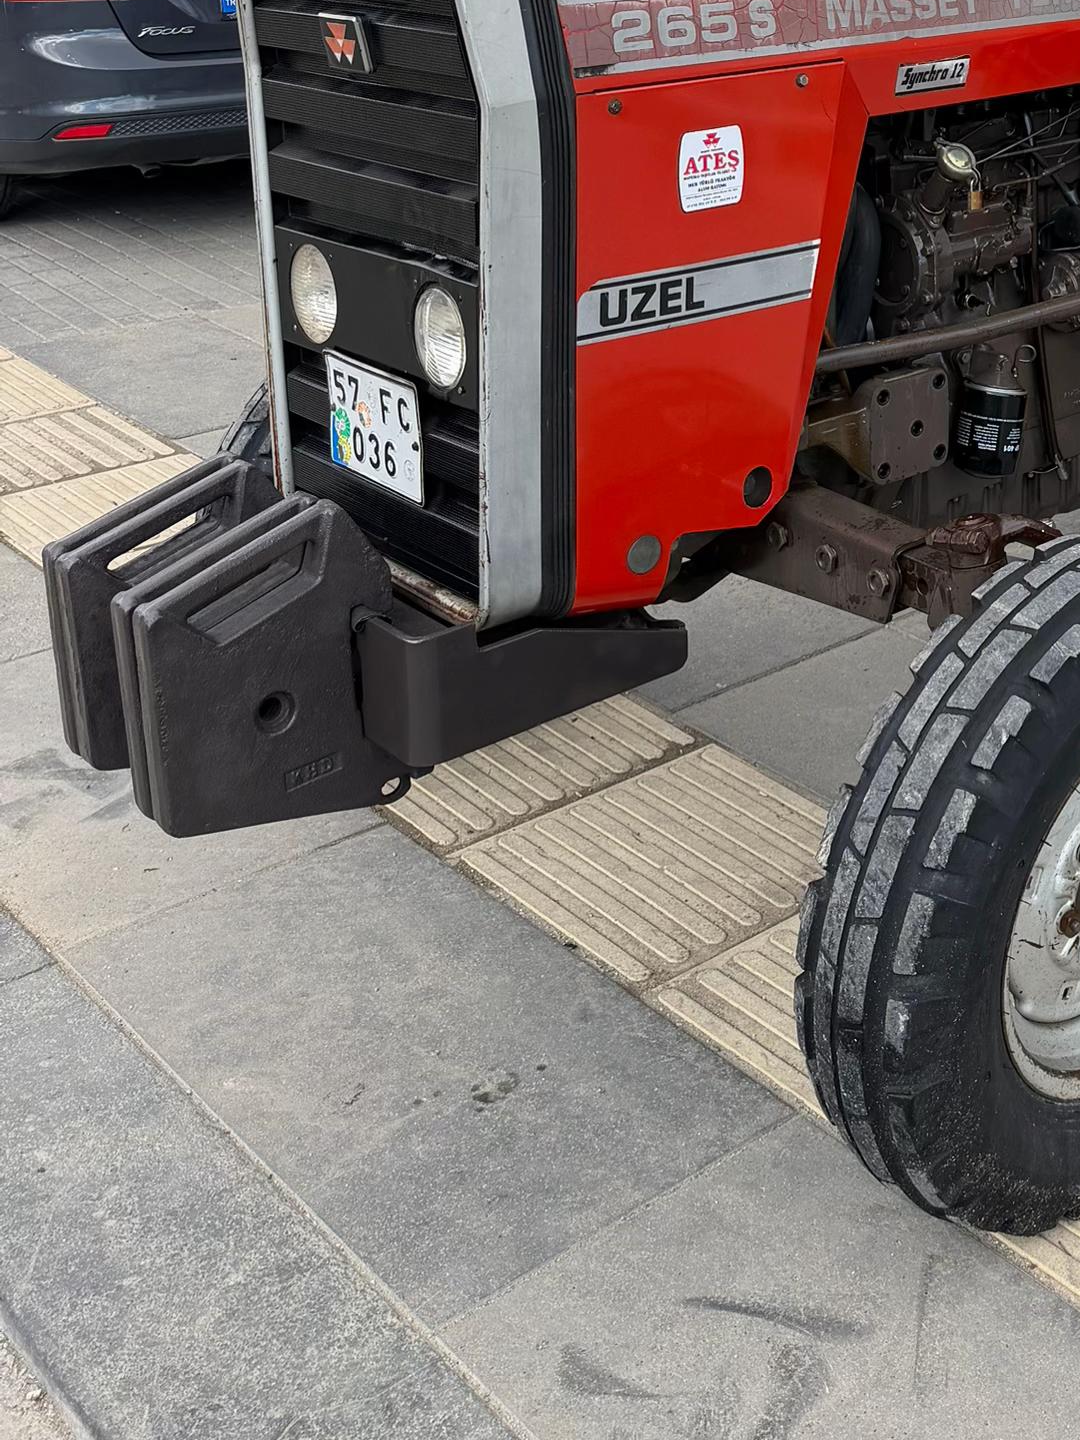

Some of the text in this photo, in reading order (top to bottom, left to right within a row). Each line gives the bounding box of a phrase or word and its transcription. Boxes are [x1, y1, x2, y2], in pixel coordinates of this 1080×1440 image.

[611, 1, 738, 53] 265
[683, 150, 740, 176] ATEŞ
[599, 277, 705, 328] UZEL
[333, 369, 411, 433] 57 FC
[352, 426, 397, 477] 036
